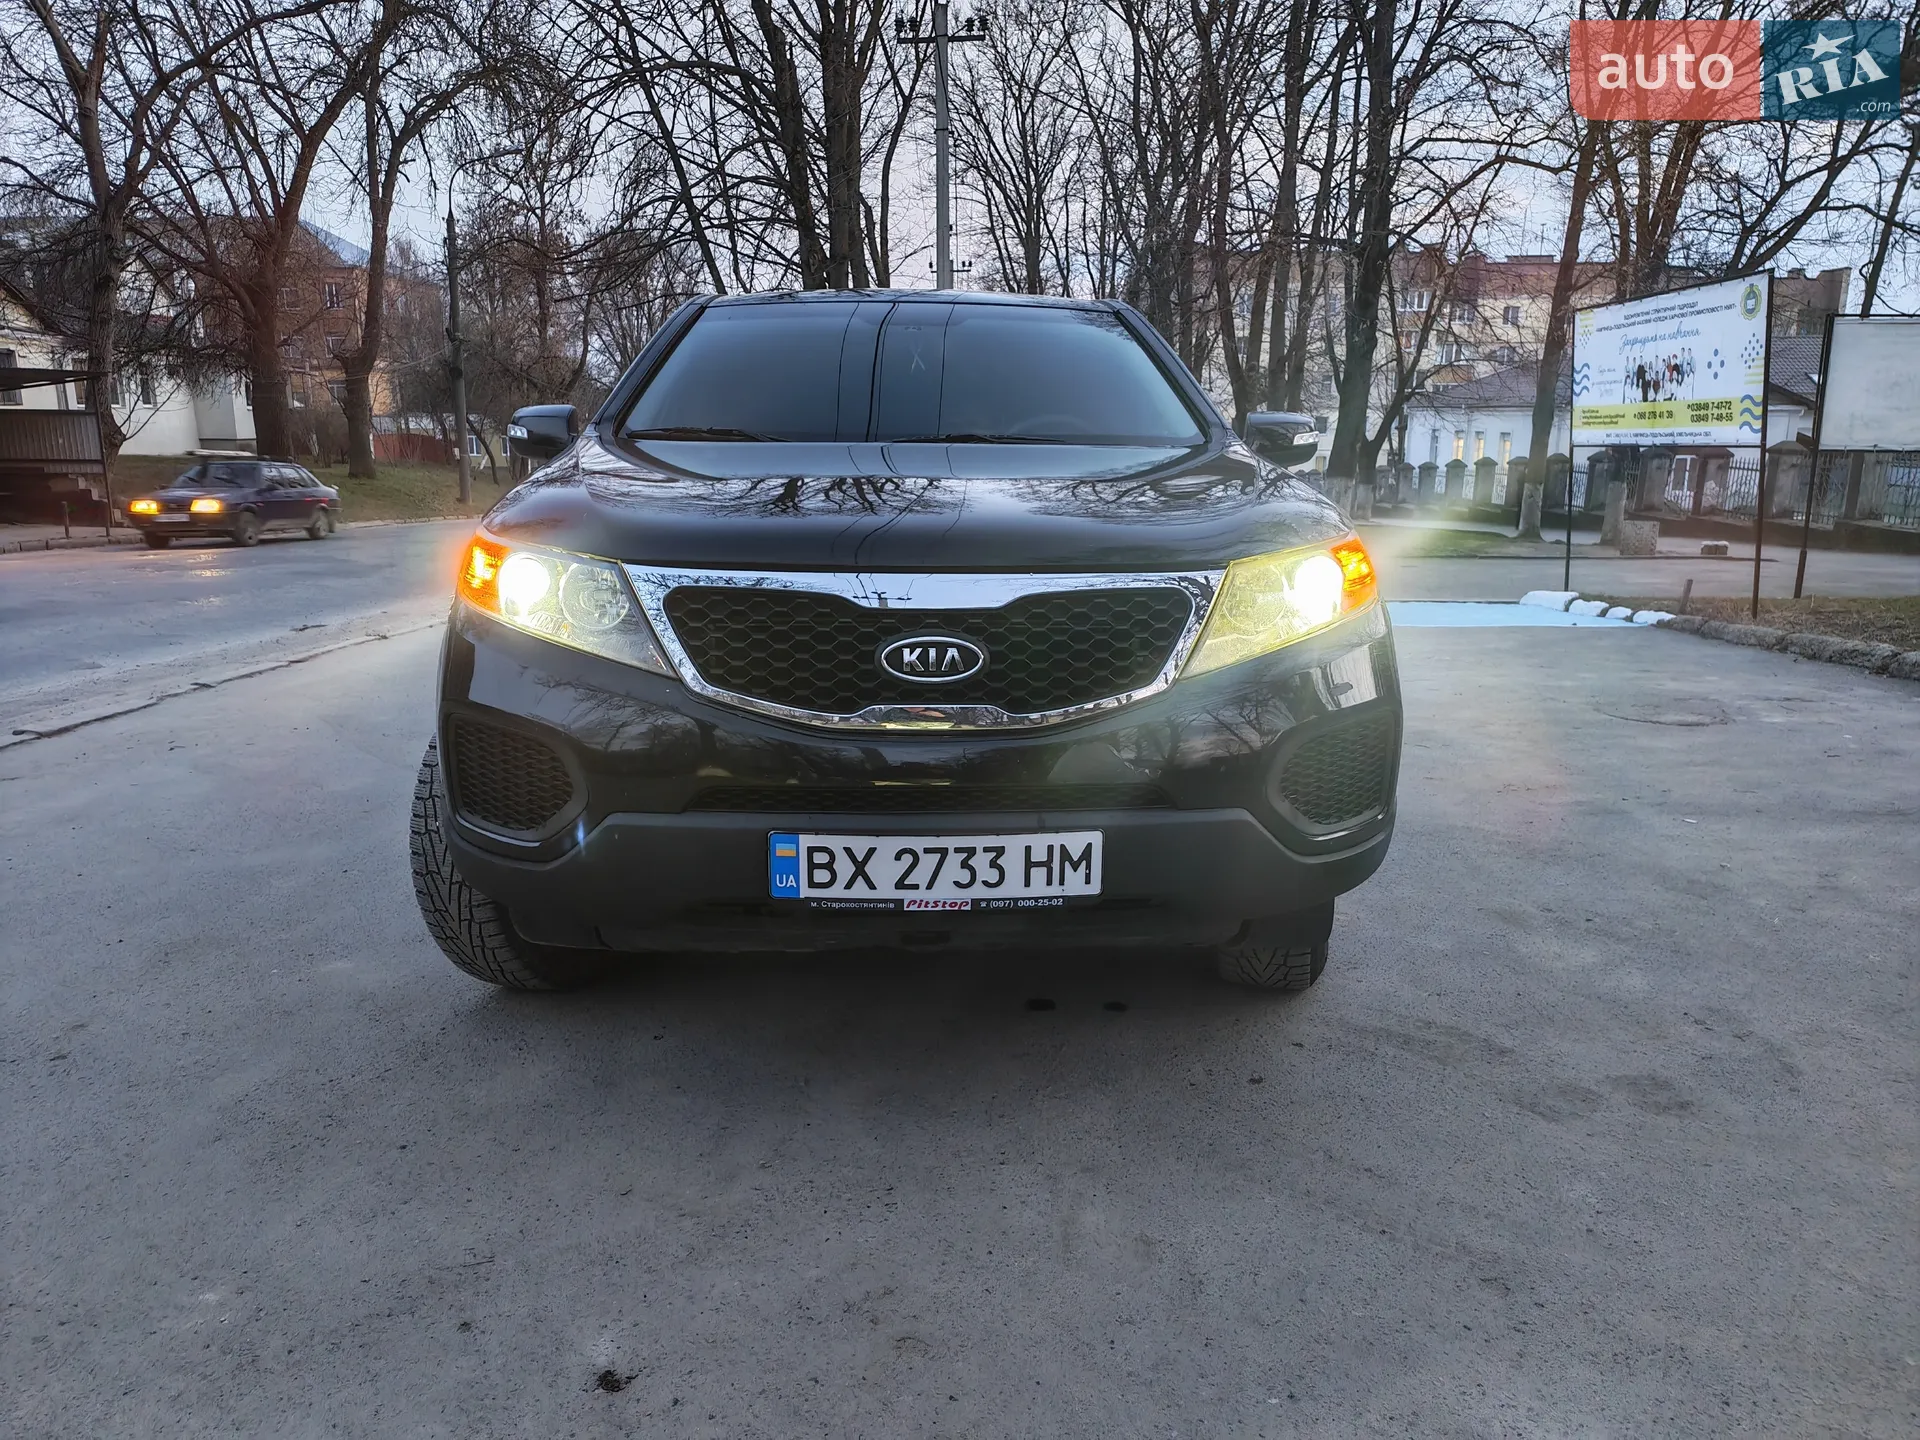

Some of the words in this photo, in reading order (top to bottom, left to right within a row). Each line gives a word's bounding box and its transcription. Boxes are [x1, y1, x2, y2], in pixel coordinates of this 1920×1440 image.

[902, 647, 965, 672] KIA
[806, 845, 877, 890] BX
[894, 846, 1006, 890] 2733
[1024, 842, 1093, 888] HM
[776, 874, 797, 888] UA
[905, 899, 970, 910] PitStop
[990, 900, 1013, 909] (097)
[1017, 898, 1063, 907] 000-25-02
